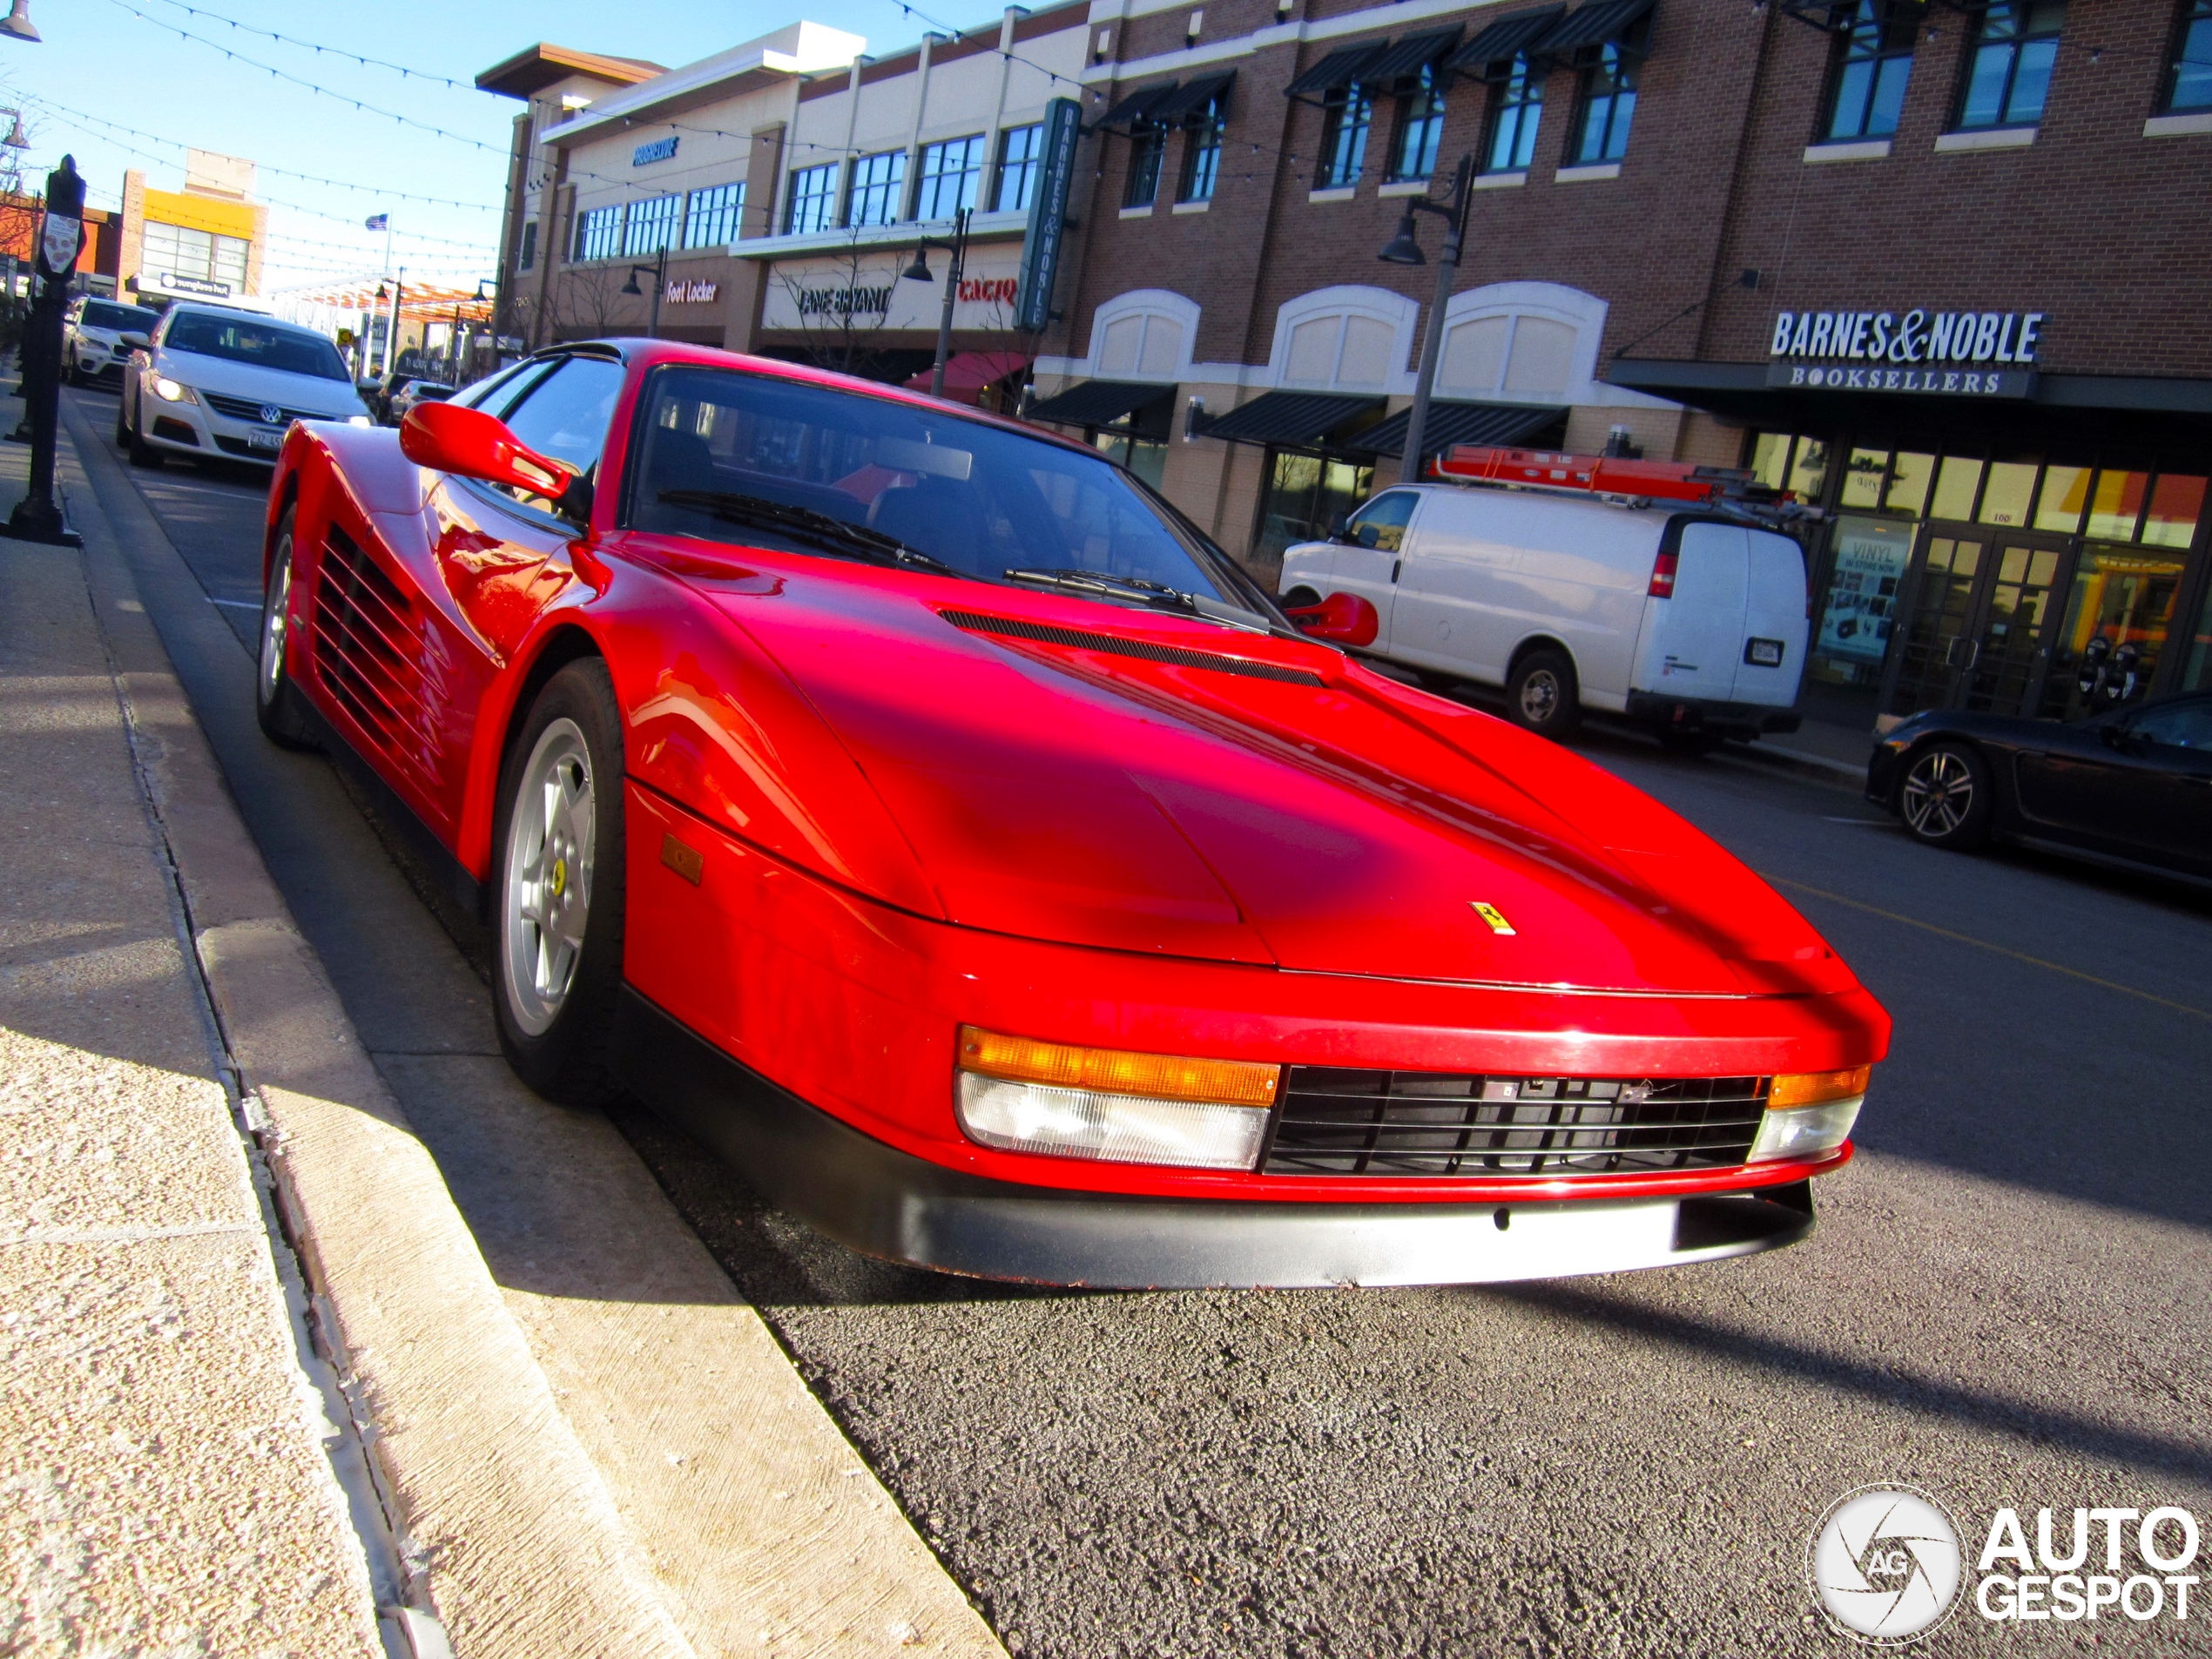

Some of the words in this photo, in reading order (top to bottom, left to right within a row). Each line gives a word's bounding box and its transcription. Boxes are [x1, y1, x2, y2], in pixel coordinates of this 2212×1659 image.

[176, 280, 212, 292] sunglass
[213, 284, 228, 295] hut
[667, 280, 685, 303] Foot
[686, 279, 717, 302] Locker
[1770, 309, 2043, 363] BARNES&NOBLE
[1790, 368, 2000, 394] BOOKSELLERS
[1994, 514, 2010, 523] 100
[1853, 542, 1894, 563] VINYL
[1845, 559, 1854, 568] IN
[1855, 560, 1878, 571] STORE
[1878, 563, 1897, 574] NOW
